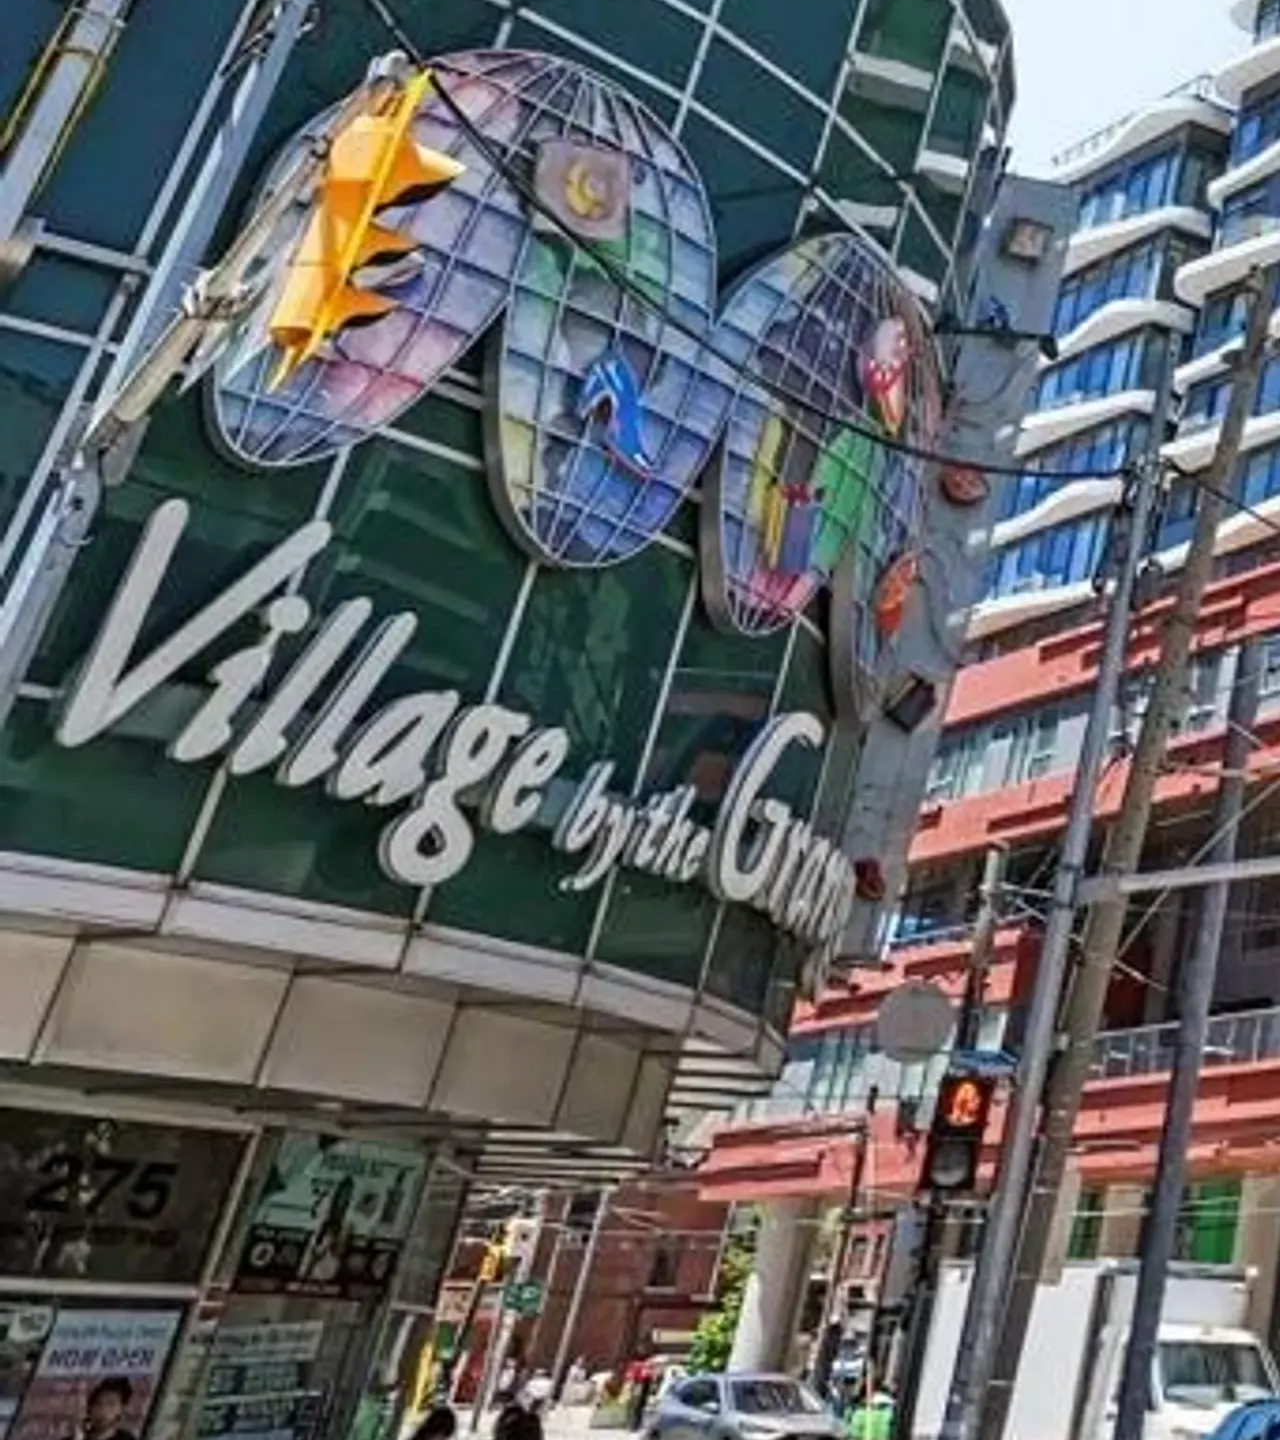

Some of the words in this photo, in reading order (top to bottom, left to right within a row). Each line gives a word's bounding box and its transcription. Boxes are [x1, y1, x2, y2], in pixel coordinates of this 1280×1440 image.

[56, 499, 570, 887] Village
[555, 761, 634, 891] by
[632, 784, 711, 883] the
[27, 1153, 180, 1219] 275
